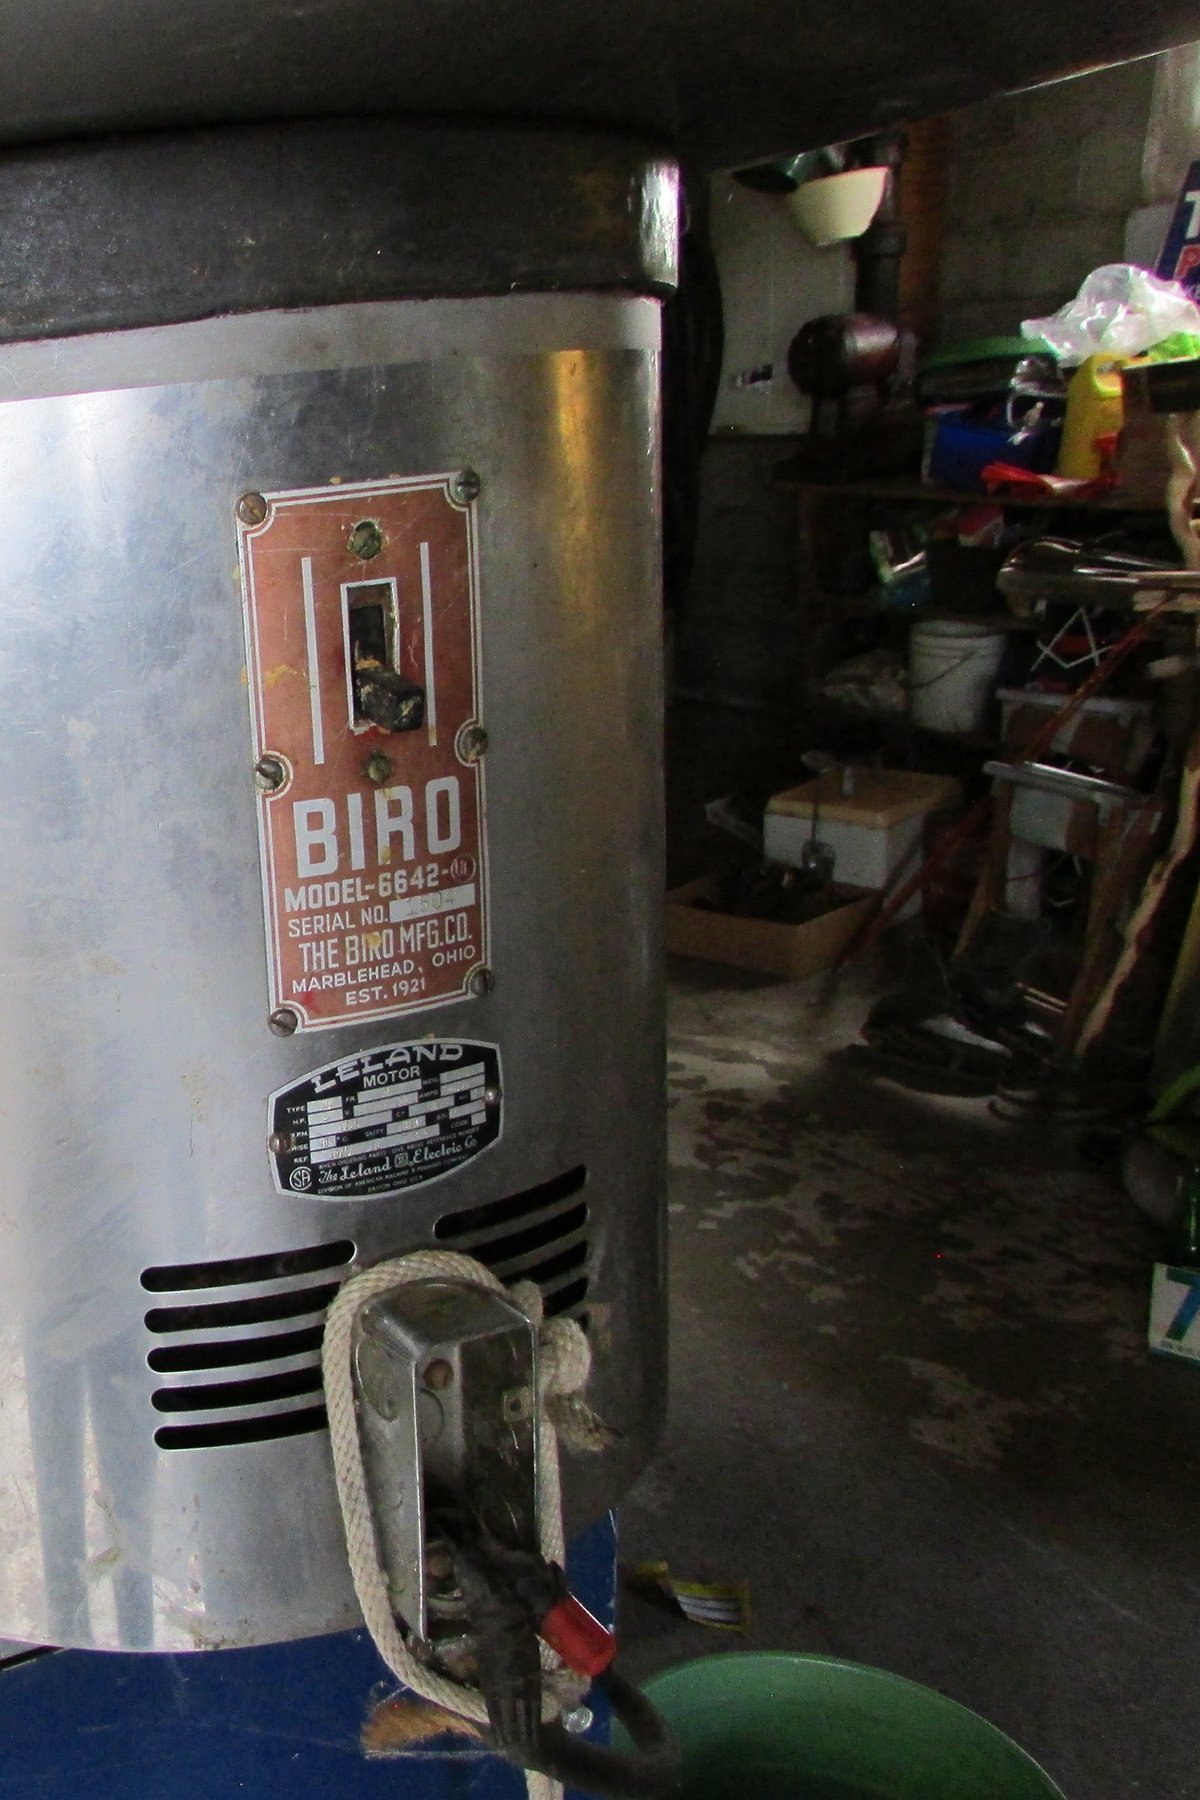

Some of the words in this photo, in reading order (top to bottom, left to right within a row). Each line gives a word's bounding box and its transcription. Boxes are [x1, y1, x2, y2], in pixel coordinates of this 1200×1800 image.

[293, 776, 461, 878] BIRO
[288, 912, 355, 938] SERIAL
[361, 905, 388, 926] NO.
[299, 938, 339, 973] THE
[345, 929, 394, 966] BIRO
[432, 945, 475, 968] OHIO
[345, 986, 388, 1006] EST.
[392, 977, 426, 998] 1921
[311, 1044, 463, 1093] LELAND
[363, 1065, 420, 1089] MOTOR
[286, 1105, 306, 1113] TYPE
[318, 1170, 338, 1184] The
[340, 1156, 392, 1181] Leland
[413, 1143, 462, 1164] Electric
